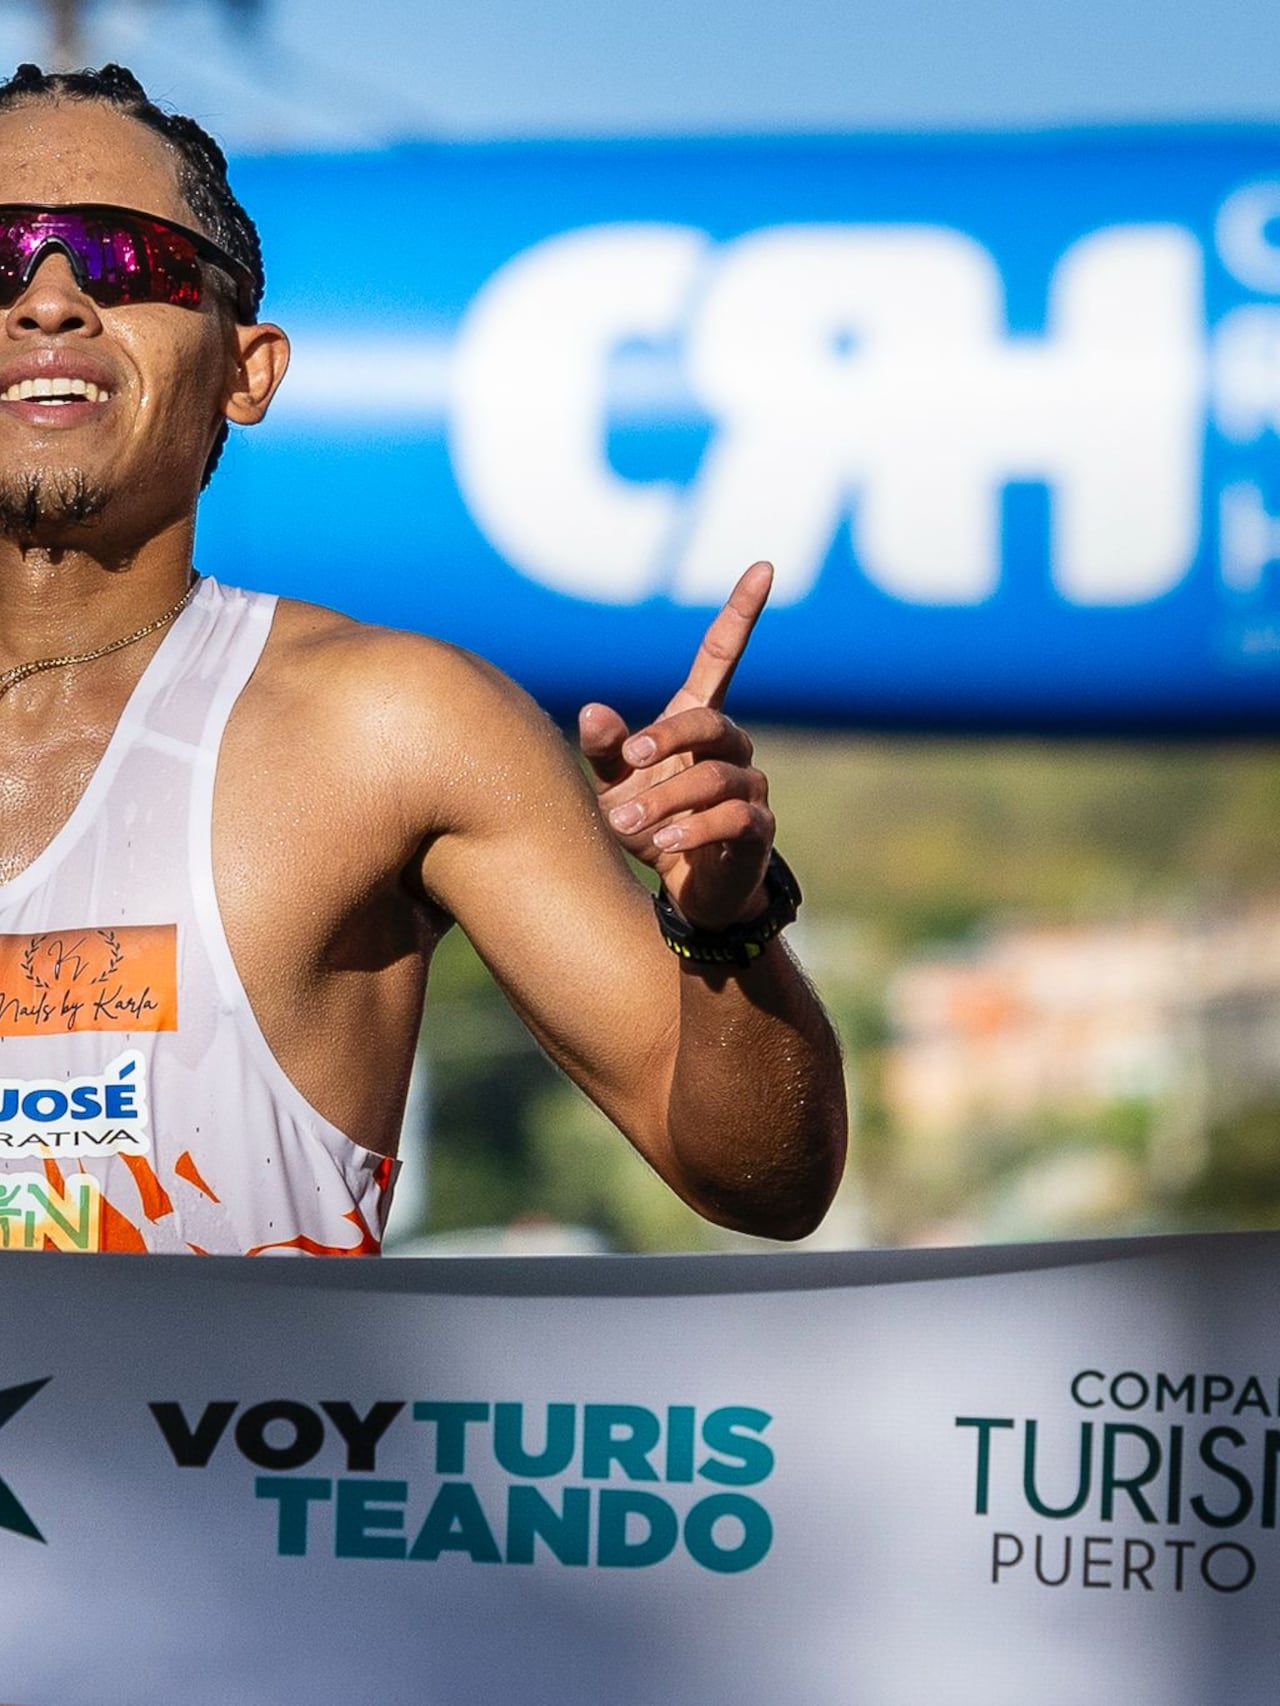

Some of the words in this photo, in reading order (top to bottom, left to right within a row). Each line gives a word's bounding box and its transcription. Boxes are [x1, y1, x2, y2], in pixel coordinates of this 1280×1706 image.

[447, 222, 1204, 604] CRH
[60, 989, 84, 1030] by
[93, 986, 159, 1021] Karla
[1070, 1369, 1280, 1418] COMPA
[955, 1416, 1280, 1529] TURIS
[255, 1476, 774, 1575] TEANDO
[991, 1532, 1257, 1594] PUERTO
